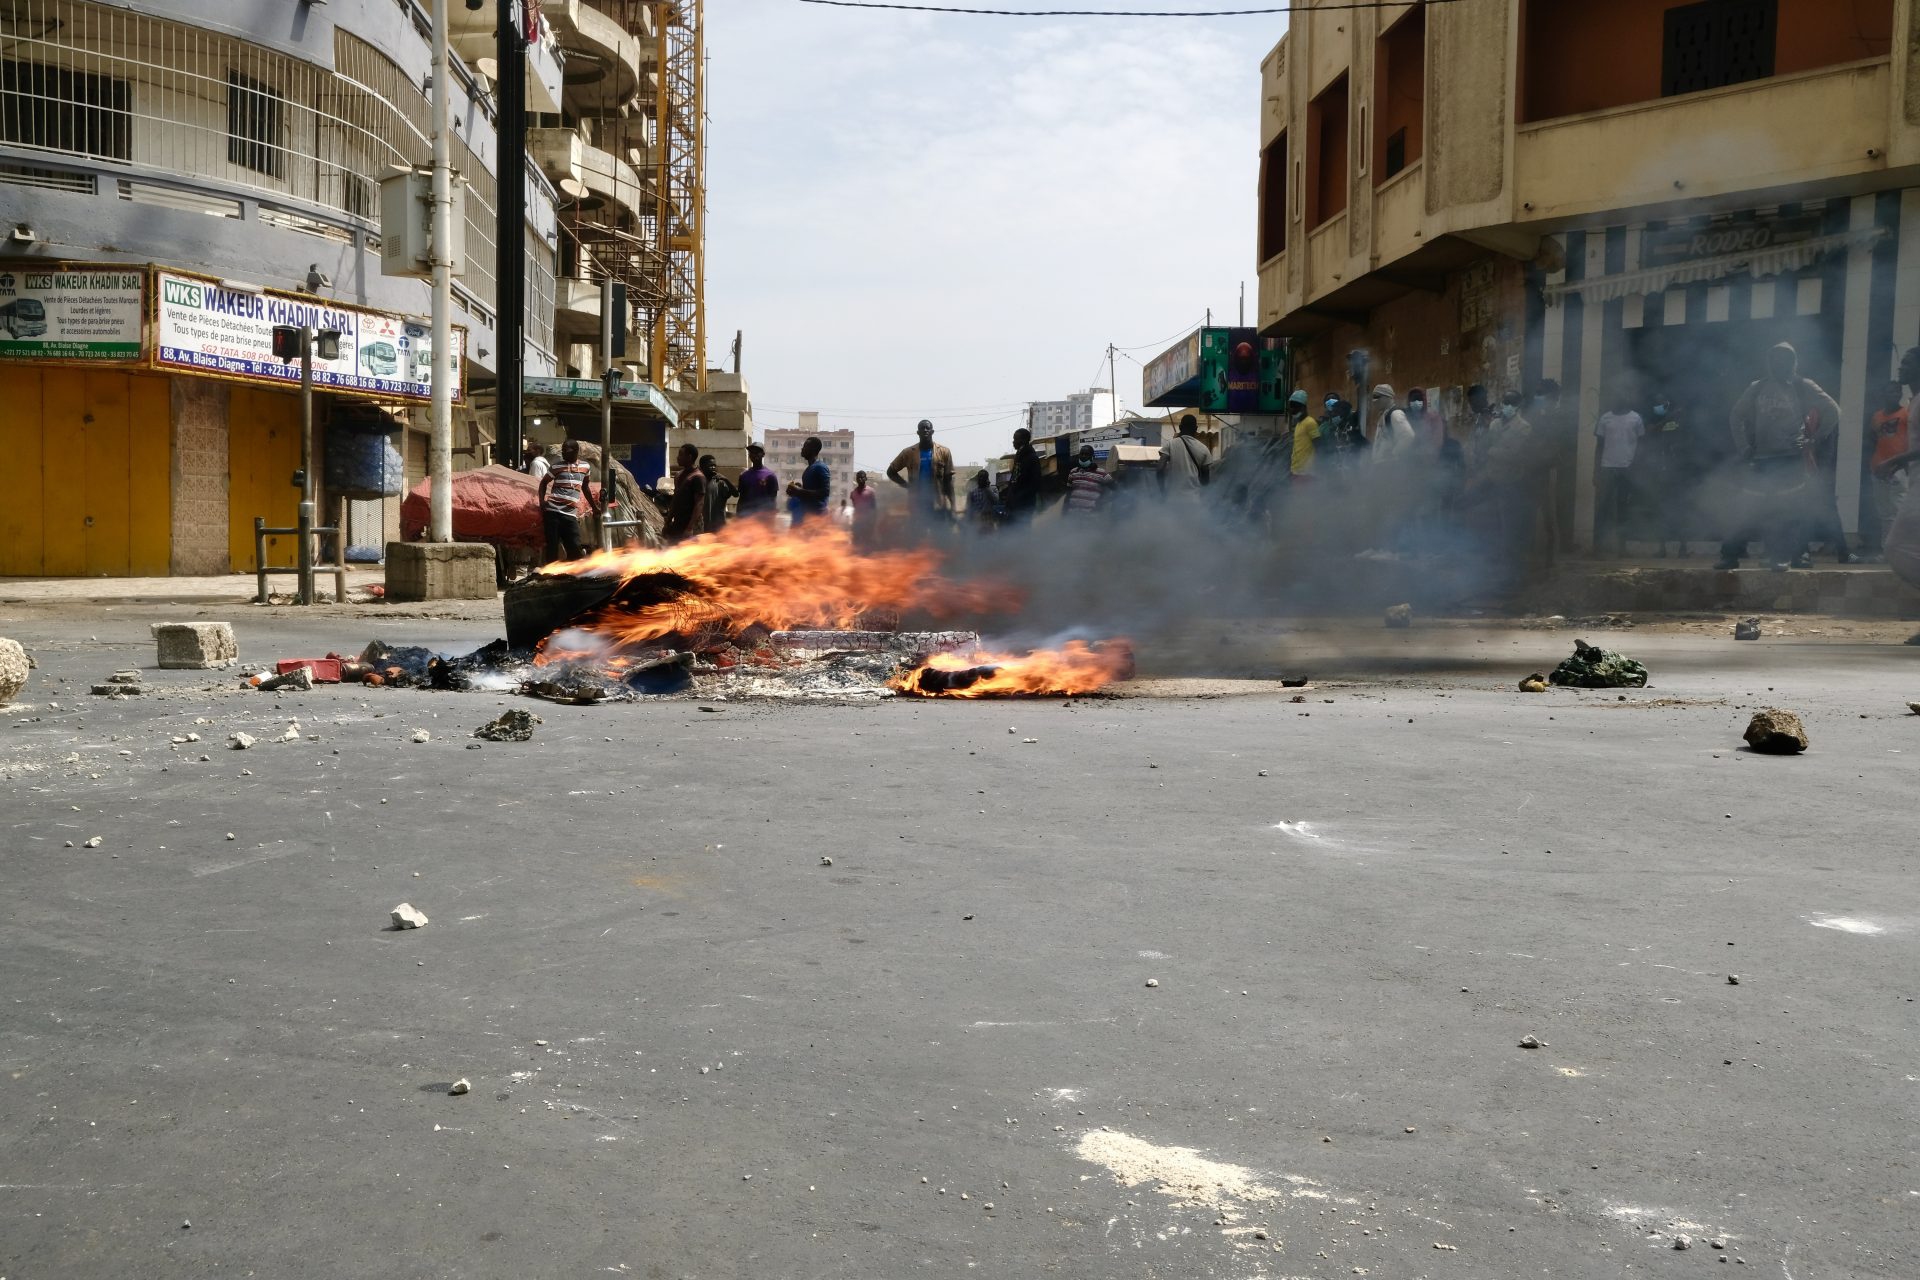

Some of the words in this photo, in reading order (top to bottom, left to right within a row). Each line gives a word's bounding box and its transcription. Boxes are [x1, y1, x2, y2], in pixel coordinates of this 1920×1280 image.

[1689, 228, 1771, 255] RODEO
[27, 275, 51, 289] WKS
[55, 275, 87, 289] WAKEUR
[90, 275, 119, 289] KHADIM
[122, 275, 141, 289] SARL
[79, 296, 102, 304] Détachées
[119, 297, 139, 305] Marques
[165, 281, 200, 307] WKS
[204, 286, 264, 320] WAKEUR
[268, 298, 319, 331] KHADIM
[323, 310, 353, 336] SARL
[95, 307, 111, 315] légères
[68, 317, 80, 326] types
[167, 307, 187, 321] Vente
[189, 312, 198, 323] de
[199, 315, 220, 327] Pièces
[221, 318, 254, 334] Détachées
[255, 324, 273, 336] Toute
[339, 339, 354, 351] gères
[407, 326, 421, 336] Ford
[173, 323, 189, 335] Tous
[191, 327, 209, 340] types
[211, 330, 219, 340] de
[220, 334, 235, 343] para
[236, 335, 251, 346] brise
[253, 337, 272, 349] pneus
[201, 344, 217, 355] SG2
[220, 347, 239, 357] TATA
[259, 353, 280, 364] POLO
[311, 361, 328, 370] ONG
[397, 348, 411, 357] TATA
[163, 348, 176, 361] 88,
[178, 350, 191, 362] Av.
[193, 352, 216, 366] Blaise
[218, 357, 245, 372] Diagne
[252, 361, 262, 374] Tél
[268, 365, 285, 377] +221
[288, 368, 296, 379] 77
[312, 371, 320, 381] 68
[322, 373, 331, 383] 82
[336, 374, 344, 384] 76
[345, 375, 357, 386] 688
[360, 378, 367, 388] 16
[368, 379, 376, 389] 68
[381, 381, 389, 391] 70
[390, 382, 402, 392] 723
[403, 382, 411, 393] 24
[411, 384, 419, 394] 02
[423, 385, 431, 396] 33
